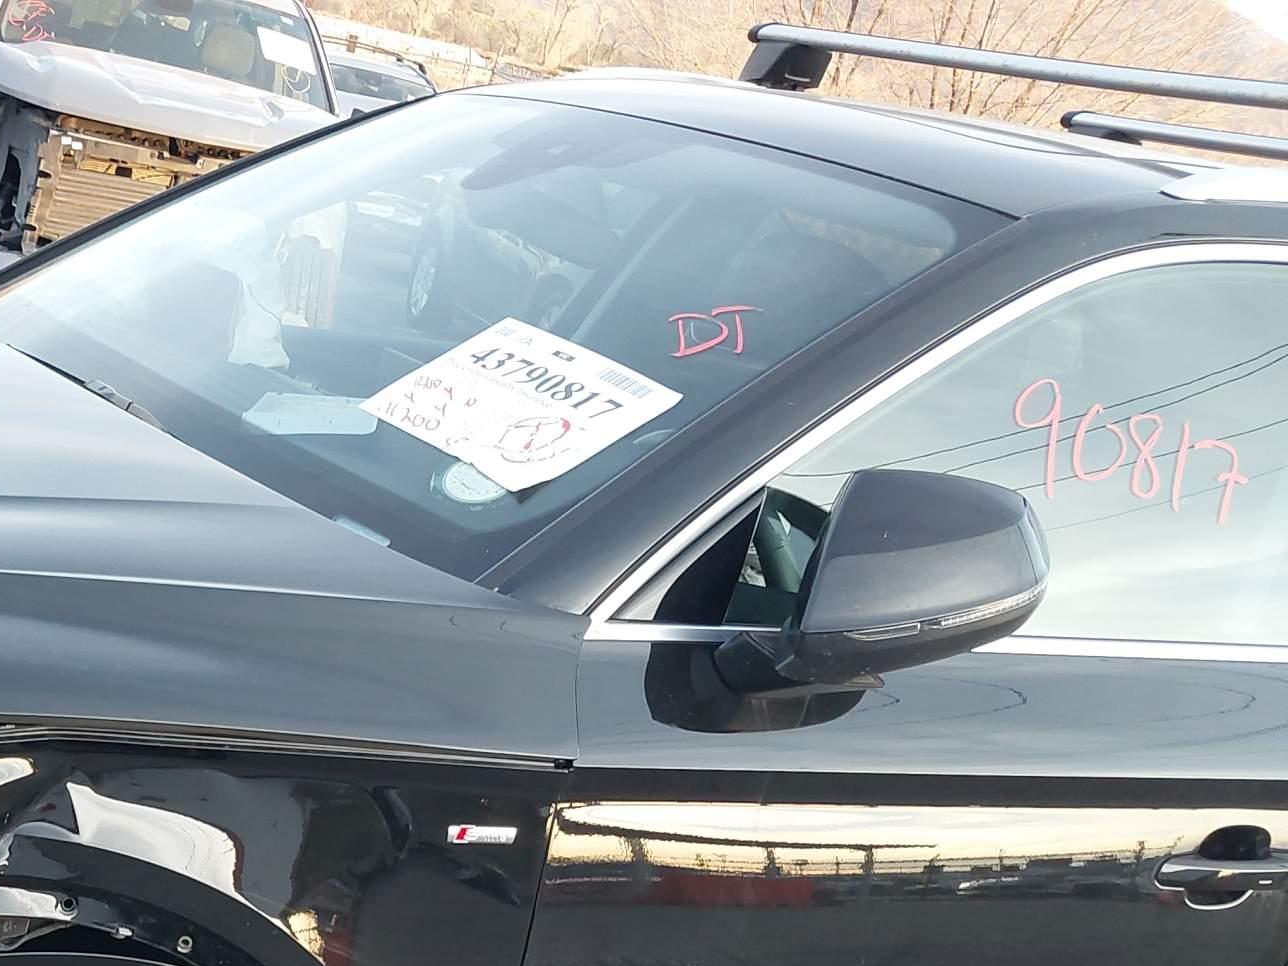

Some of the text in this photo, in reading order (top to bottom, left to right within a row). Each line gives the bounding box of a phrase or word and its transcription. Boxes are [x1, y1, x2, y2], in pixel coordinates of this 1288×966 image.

[668, 304, 764, 357] DT
[470, 347, 624, 419] 43790817
[1013, 378, 1249, 525] 90817
